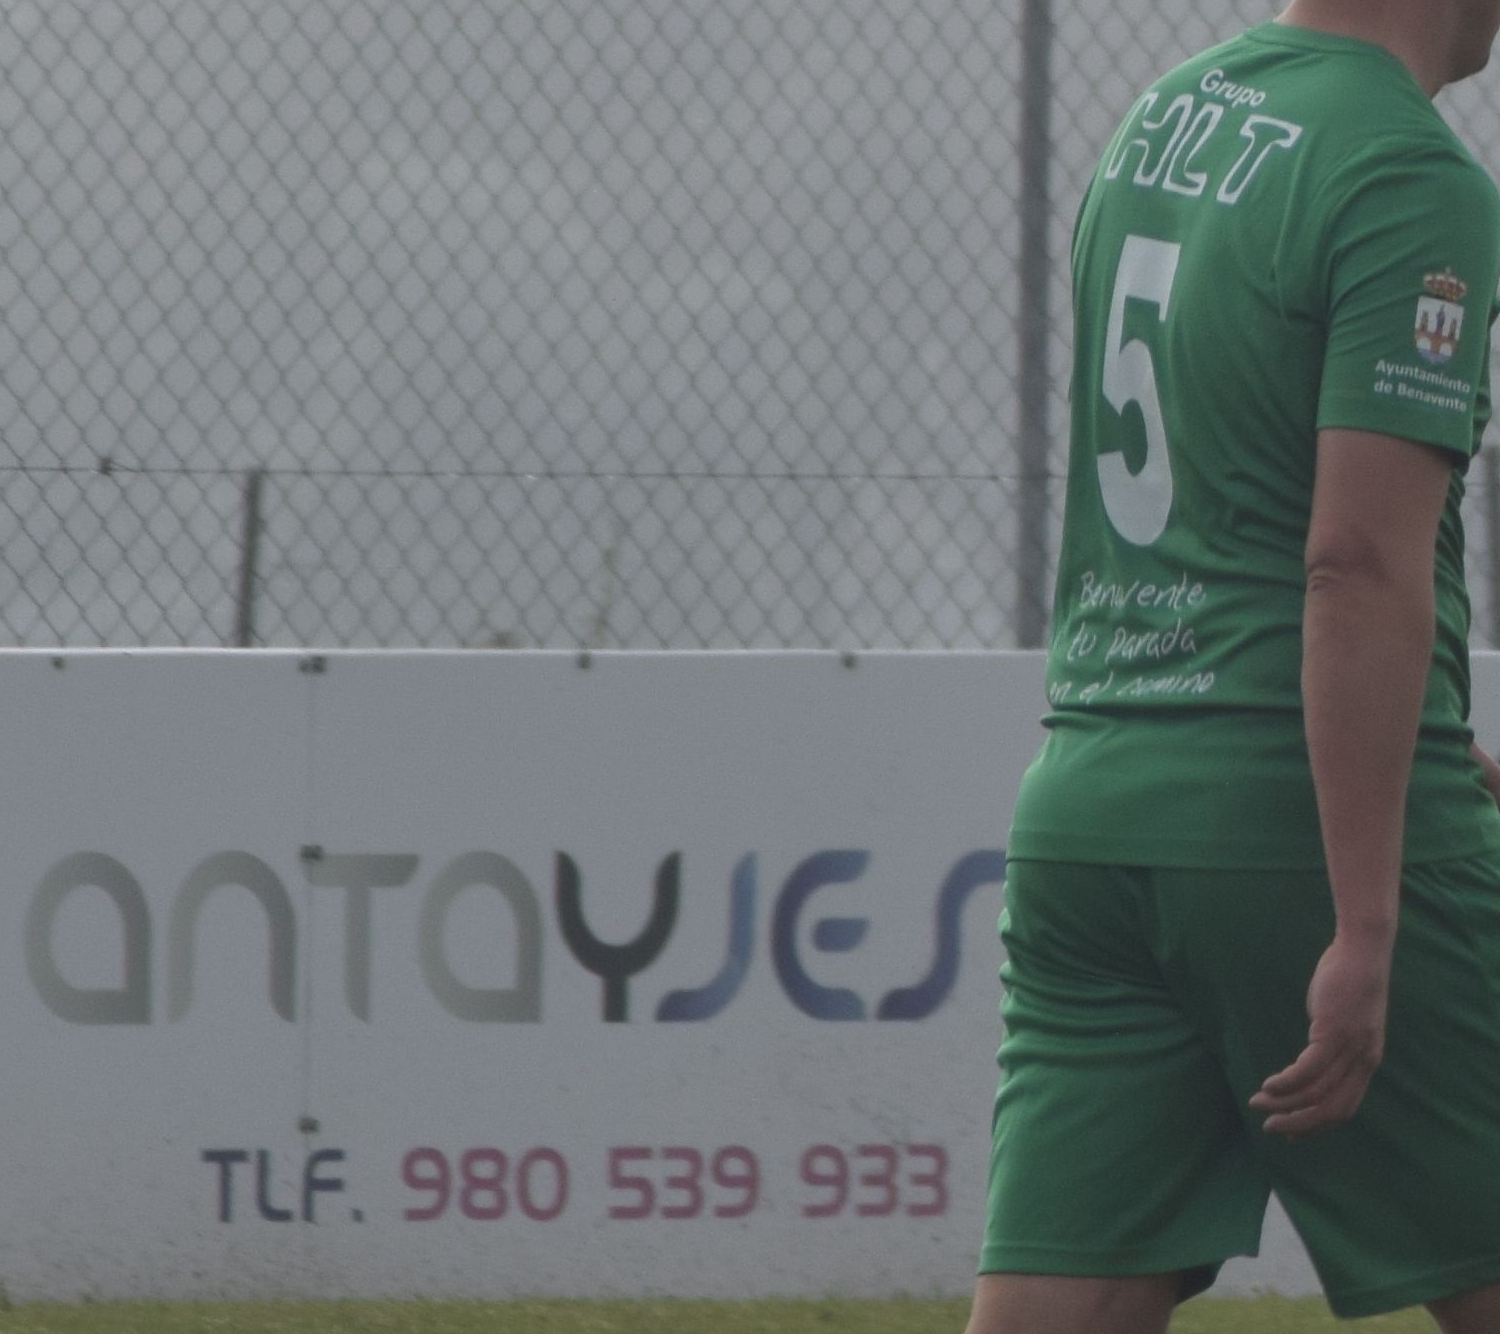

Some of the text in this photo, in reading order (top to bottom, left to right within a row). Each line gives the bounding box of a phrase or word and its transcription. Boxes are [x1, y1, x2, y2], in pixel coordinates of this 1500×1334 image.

[1200, 68, 1266, 108] Grupo
[1096, 234, 1181, 547] 5
[1373, 379, 1467, 412] de Benavente
[1374, 359, 1471, 394] Ayuntamiento
[1067, 617, 1197, 665] tu parada
[1078, 669, 1114, 705] el
[201, 1143, 950, 1224] TLF. 980 539 933
